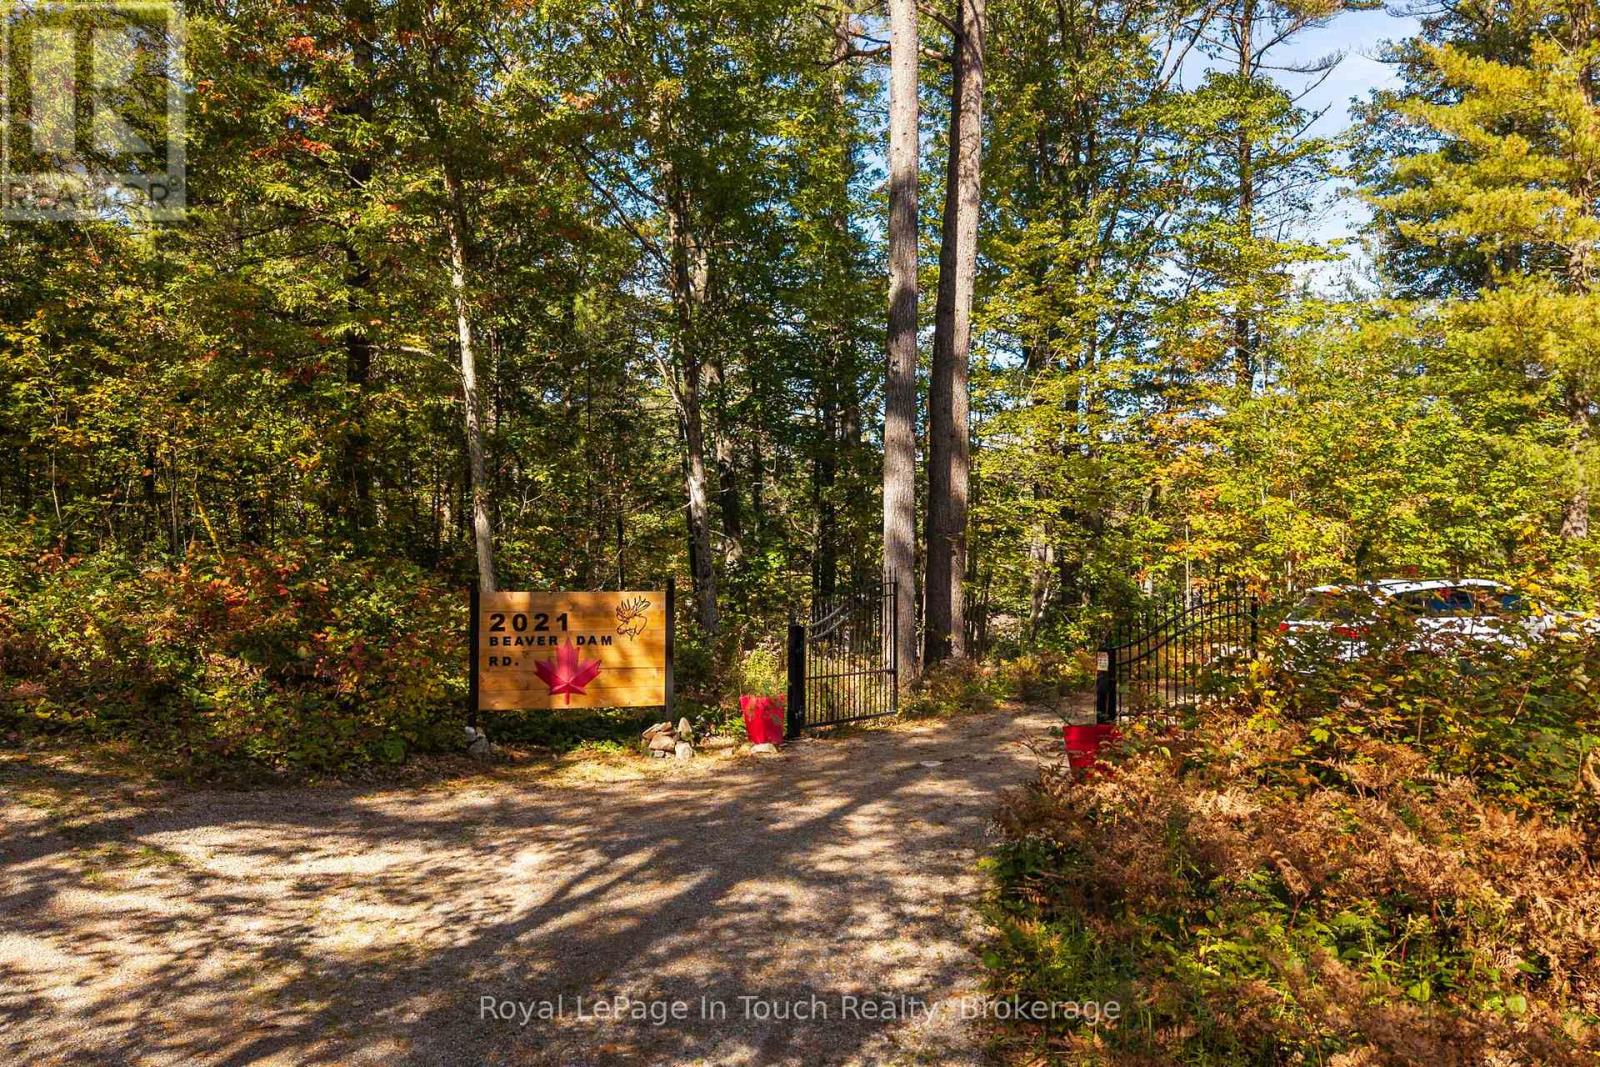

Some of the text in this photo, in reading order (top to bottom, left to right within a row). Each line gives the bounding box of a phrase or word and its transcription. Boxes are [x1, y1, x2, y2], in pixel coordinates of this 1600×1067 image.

[489, 613, 568, 632] 2021
[489, 636, 613, 646] BEAVER DAM
[489, 656, 519, 667] RD.
